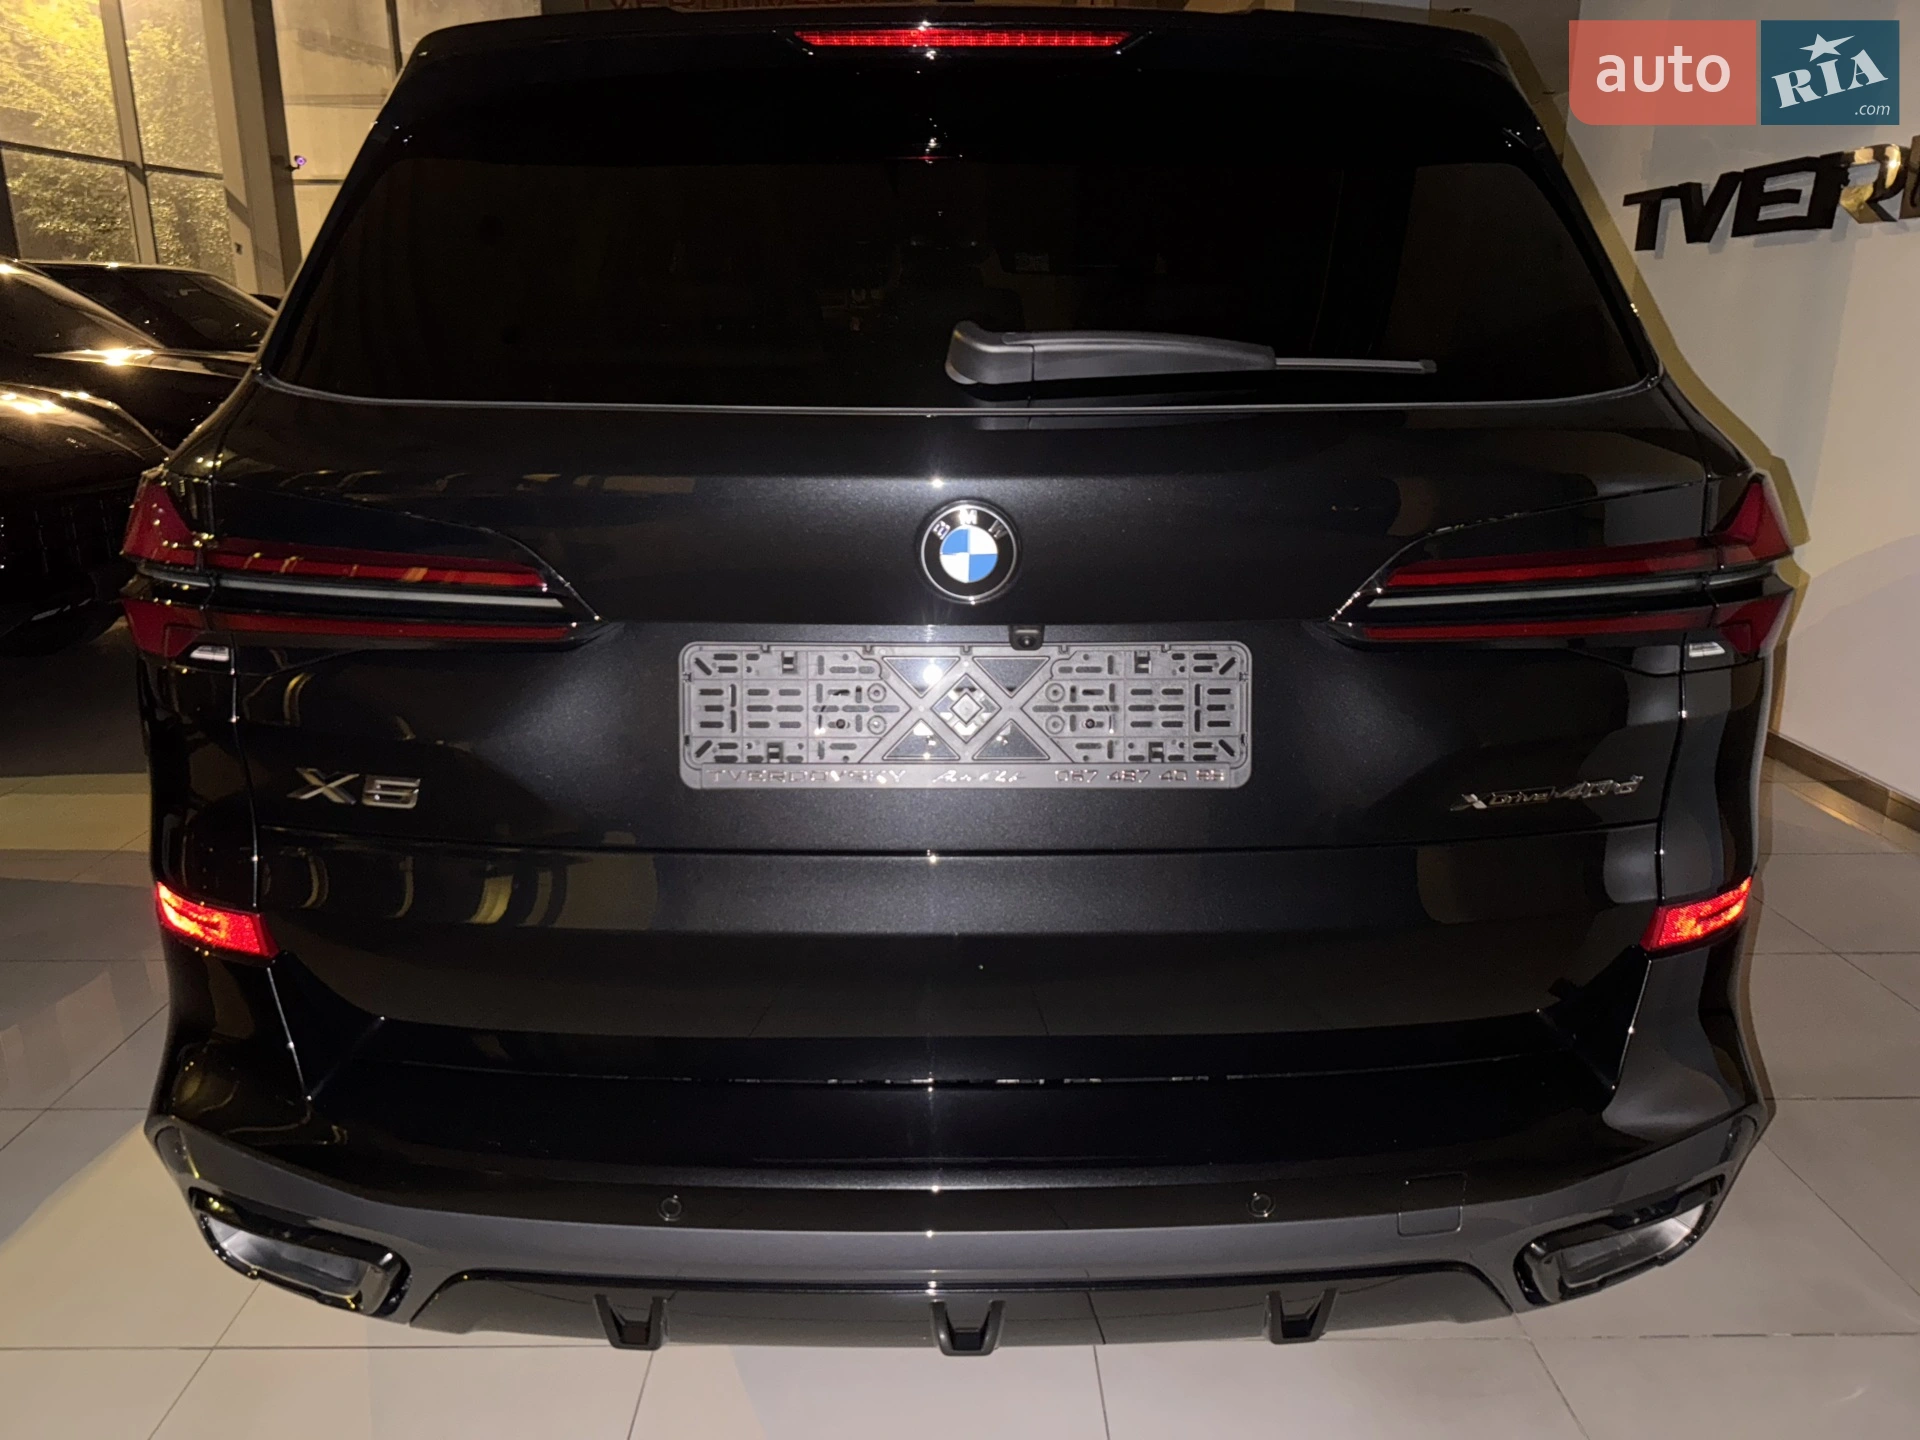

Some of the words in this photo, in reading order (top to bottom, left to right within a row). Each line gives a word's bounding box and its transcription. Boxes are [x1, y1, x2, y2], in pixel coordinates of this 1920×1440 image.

[1621, 134, 1919, 251] TVER
[932, 508, 1008, 540] BMW
[286, 767, 421, 809] X5
